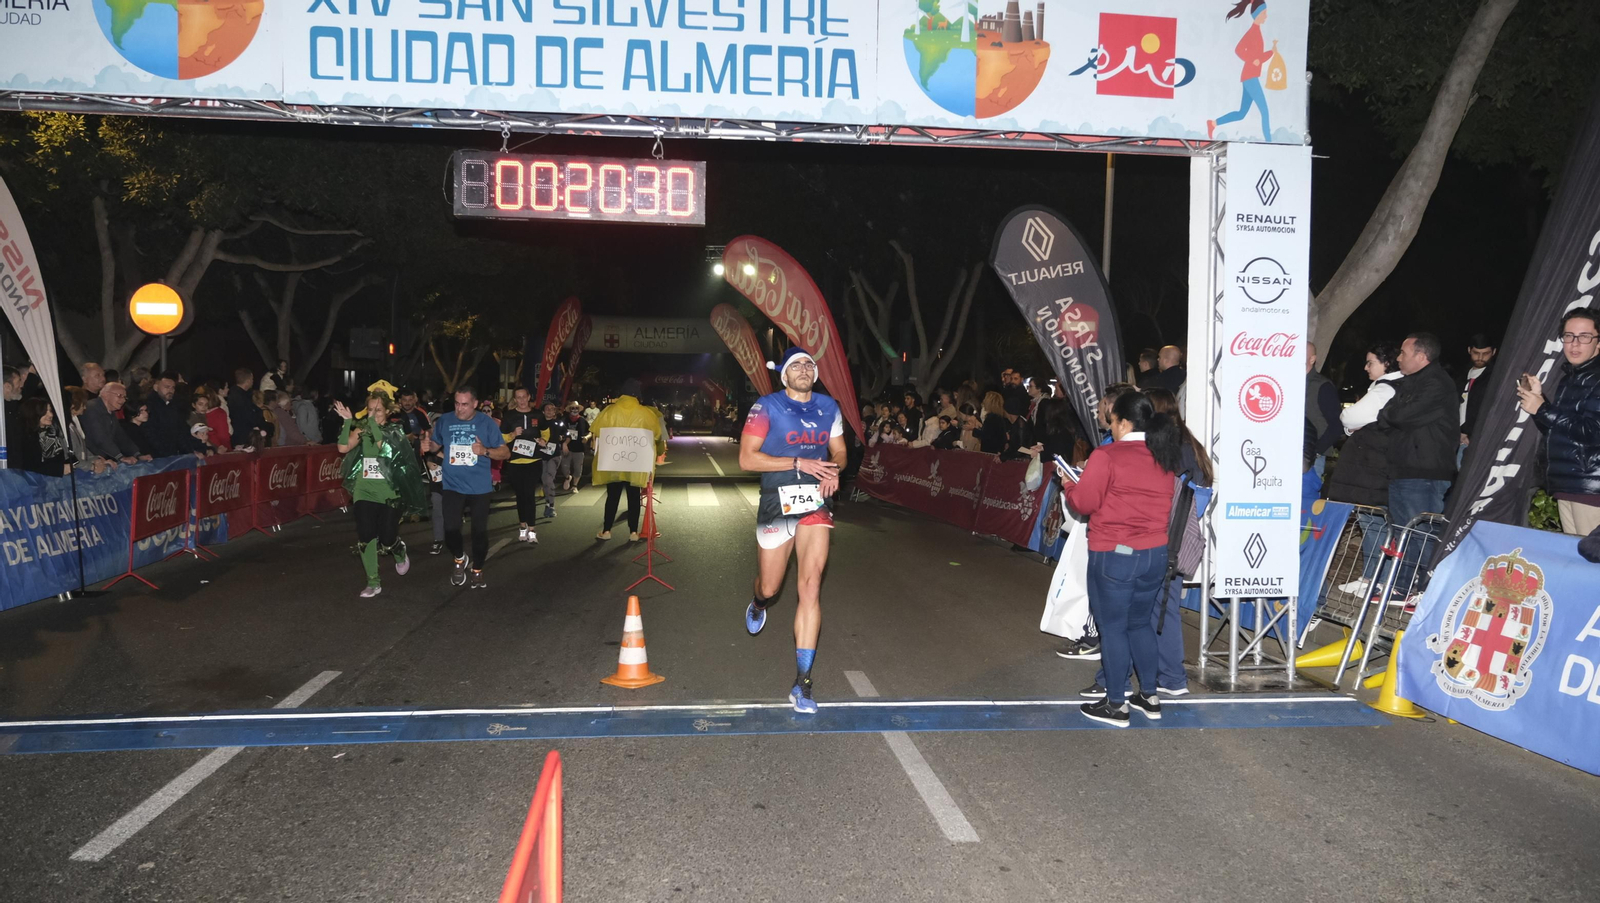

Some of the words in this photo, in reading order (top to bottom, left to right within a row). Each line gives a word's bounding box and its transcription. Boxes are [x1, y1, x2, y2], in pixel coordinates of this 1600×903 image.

[309, 25, 515, 87] CIUDAD
[535, 35, 604, 90] DE
[622, 37, 860, 100] ALMERÍA
[1236, 213, 1297, 225] RENAULT
[1236, 224, 1255, 232] SYRSA
[1256, 225, 1296, 234] AUTOMOCION
[1236, 275, 1292, 286] NISSAN
[1241, 306, 1290, 315] andalmotor.es
[633, 325, 700, 340] ALMERÍA
[1230, 331, 1300, 358] Coca-Cola
[605, 434, 648, 448] COMPRO
[785, 430, 829, 445] GALO
[518, 443, 531, 451] 838
[612, 451, 638, 462] ORO
[790, 495, 814, 504] 754
[0, 493, 119, 535] AYUNTAMIENTO
[1228, 505, 1272, 517] Almericar
[3, 538, 34, 567] DE
[36, 521, 105, 559] ALMERÍA
[1224, 577, 1284, 586] RENAULT
[1443, 682, 1465, 694] CIUDAD
[1465, 689, 1474, 697] DE
